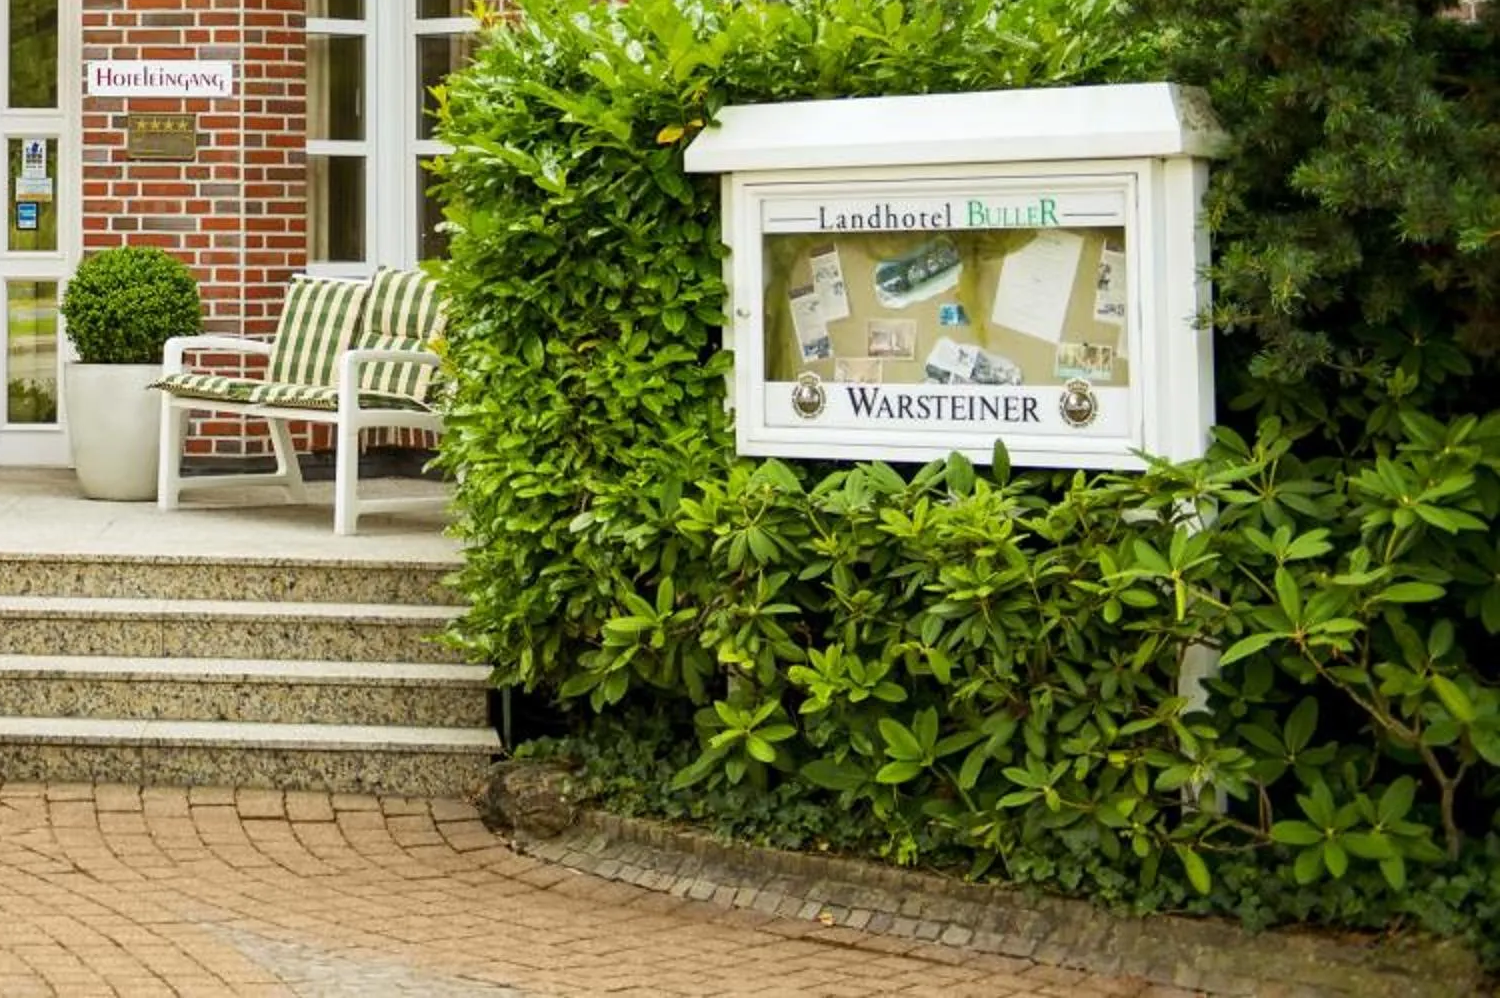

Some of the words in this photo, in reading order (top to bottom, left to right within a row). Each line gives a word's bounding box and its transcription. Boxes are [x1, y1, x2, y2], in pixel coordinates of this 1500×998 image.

[819, 202, 952, 230] Landhotel
[966, 198, 1060, 228] BULLER
[847, 386, 1042, 423] WARSTEINER
